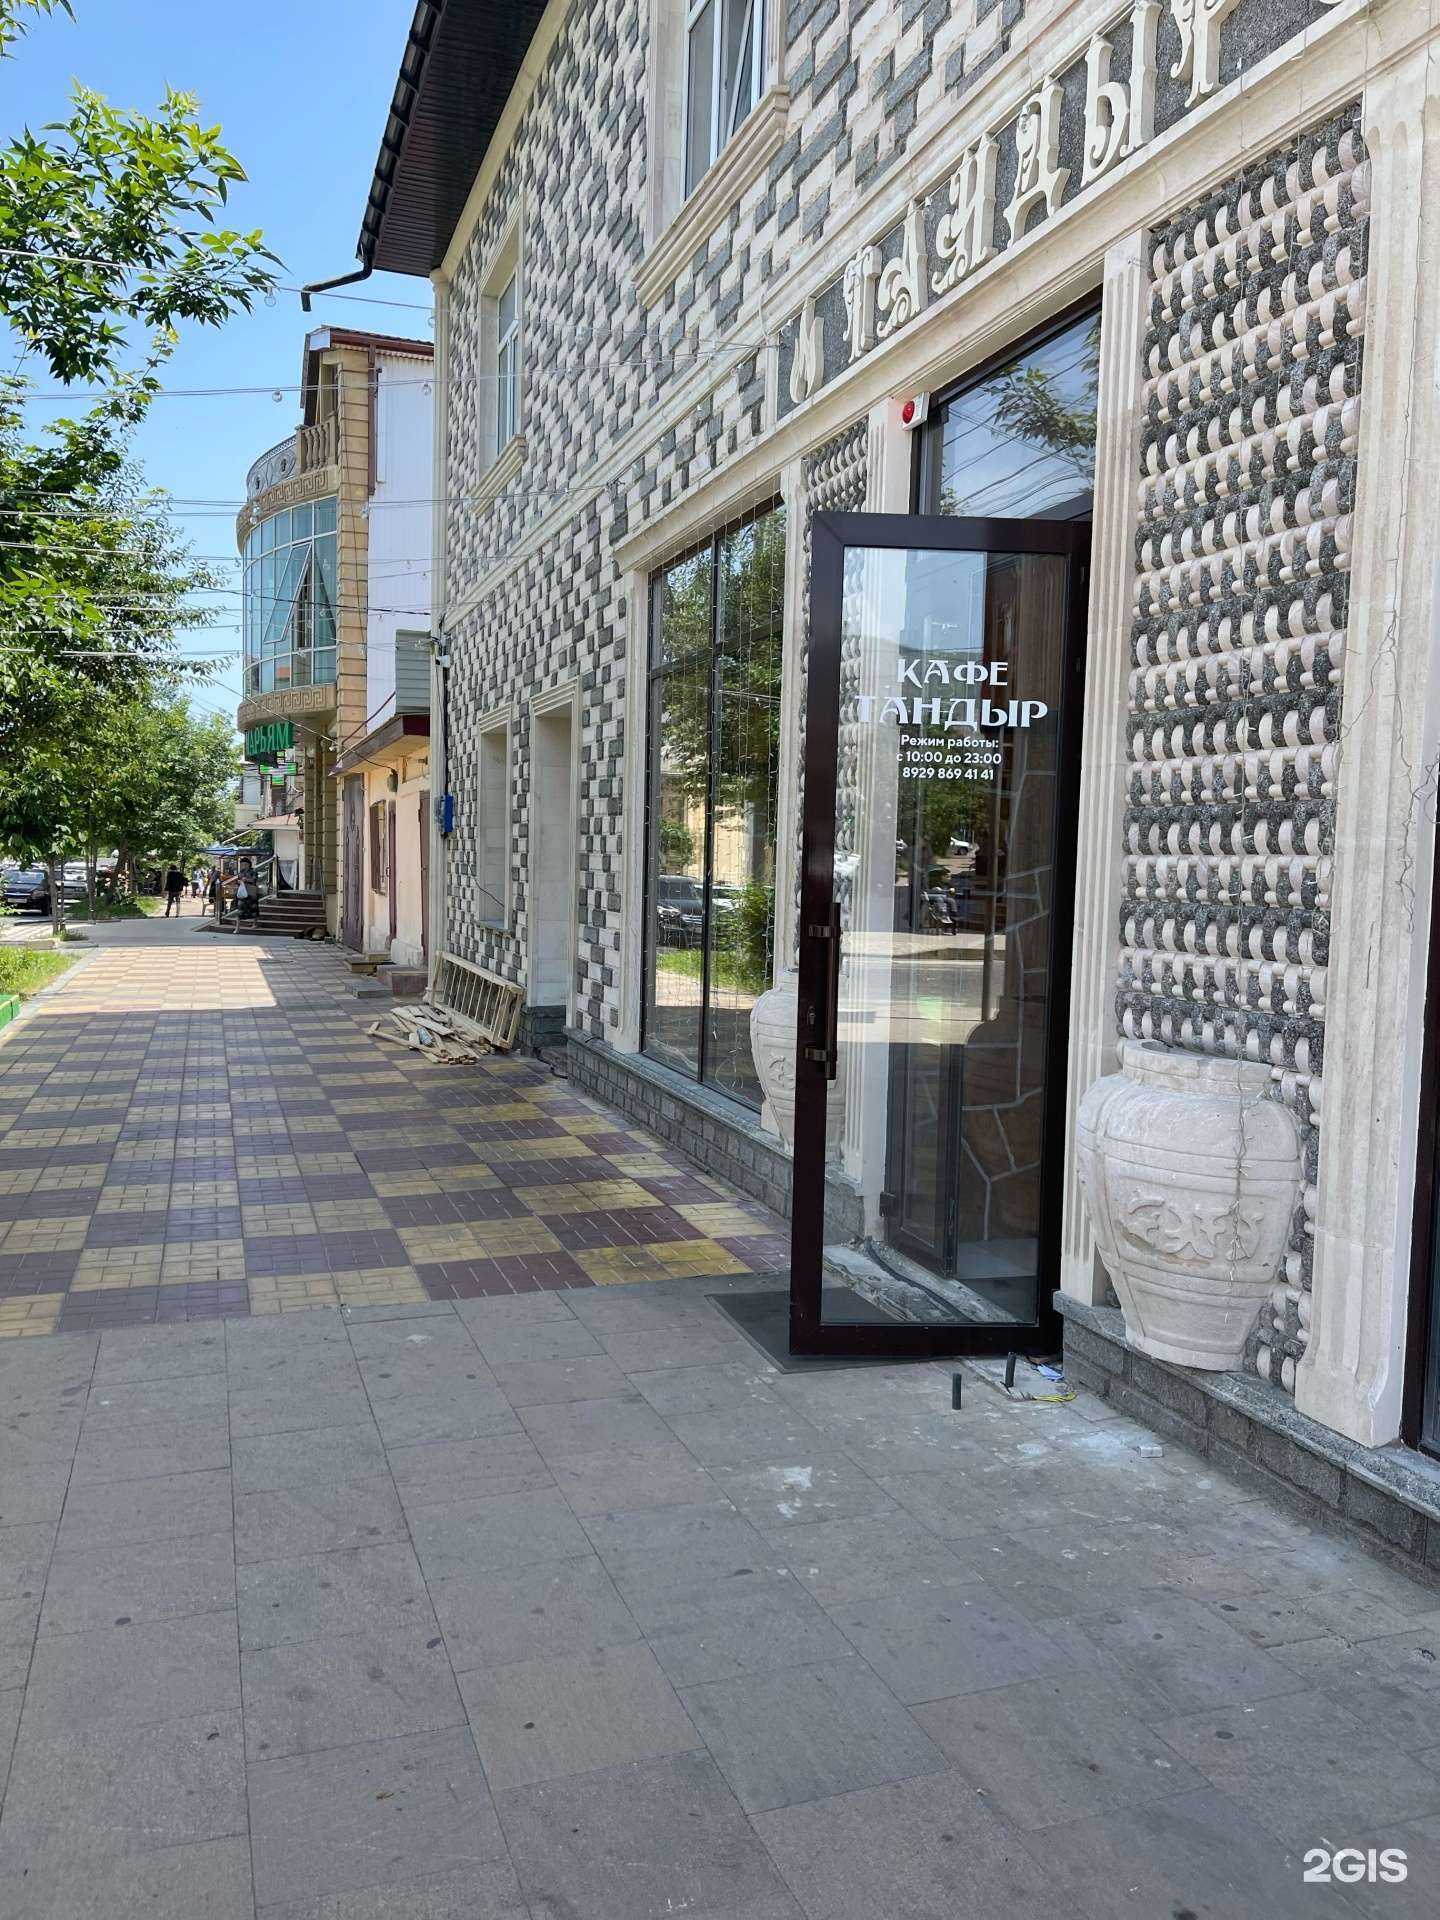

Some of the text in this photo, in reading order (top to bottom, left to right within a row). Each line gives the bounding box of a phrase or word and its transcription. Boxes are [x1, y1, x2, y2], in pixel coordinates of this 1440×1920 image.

[896, 658, 1009, 689] КАФЕ
[855, 695, 1047, 731] ТАНДЫР
[900, 735, 999, 749] Режим работы:
[896, 751, 1002, 765] с 10:00 до 23:00
[902, 767, 994, 779] 8929 869 41 41
